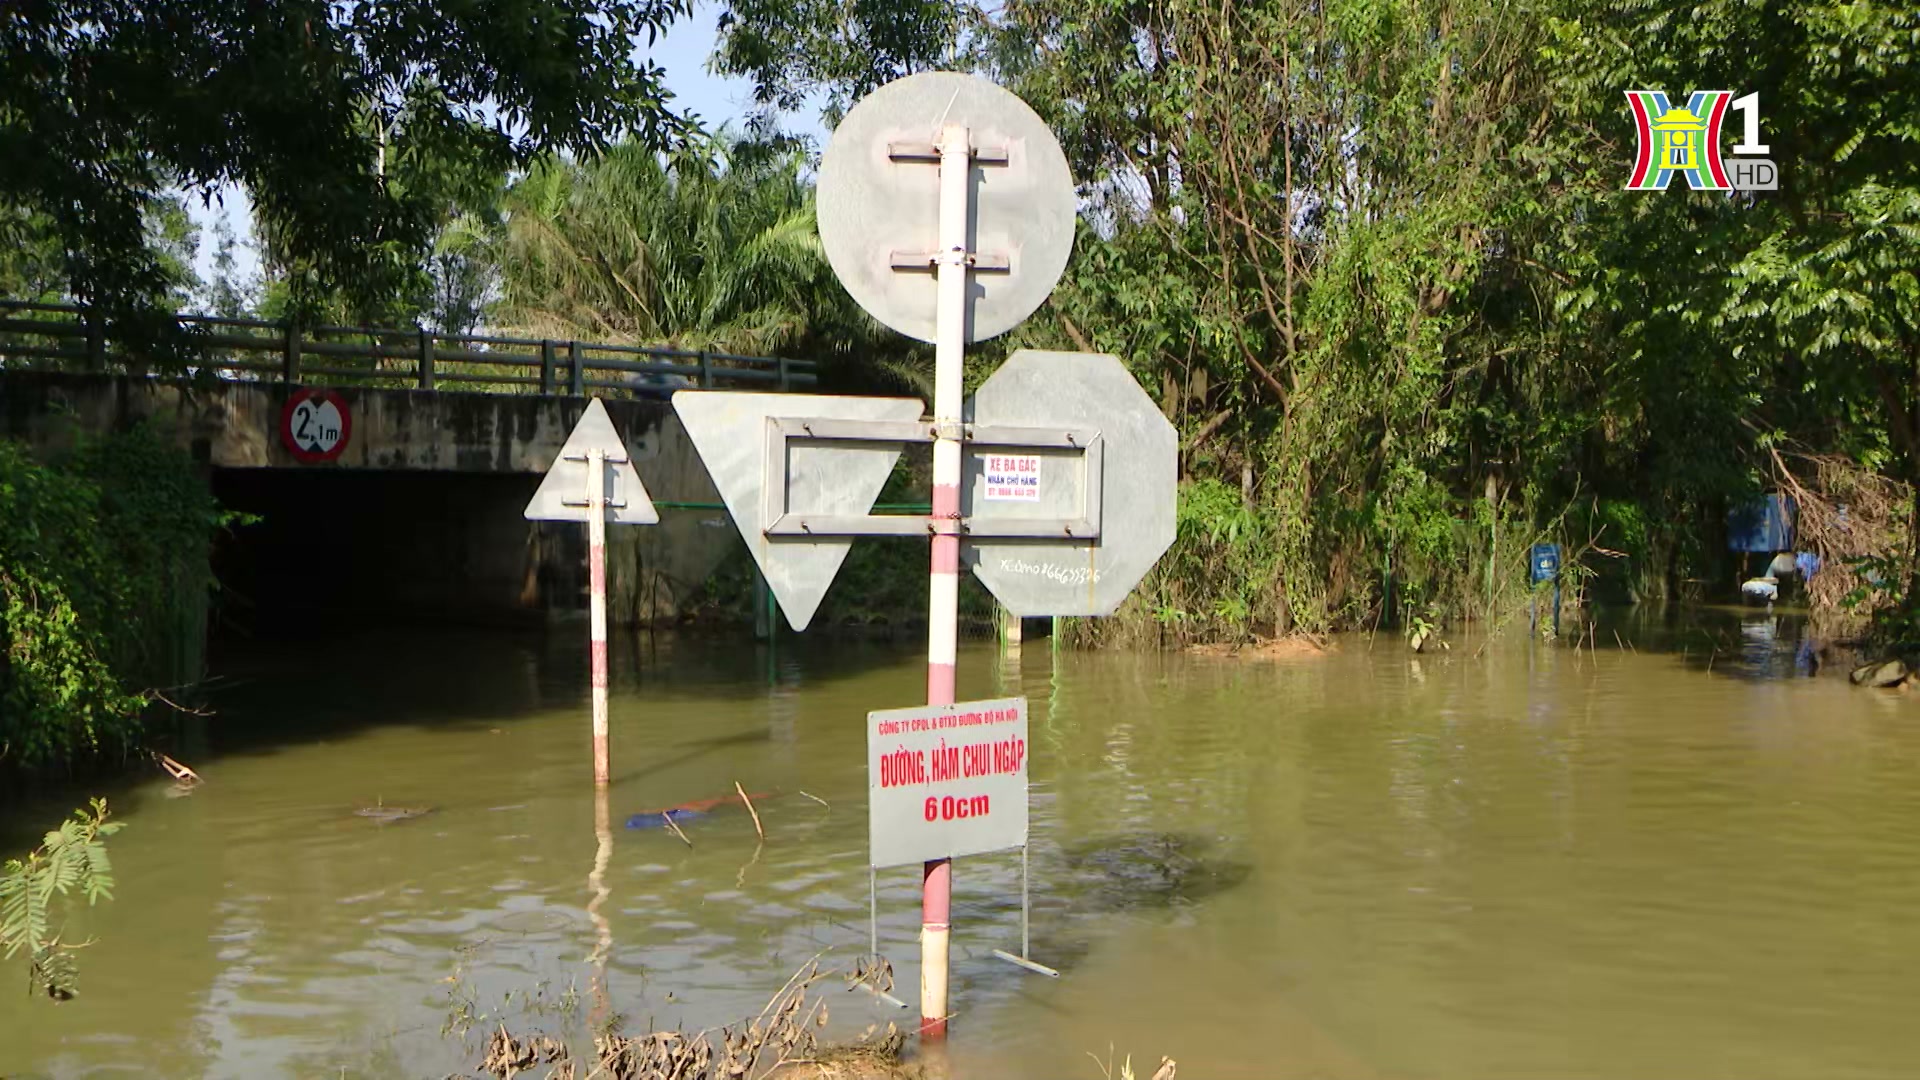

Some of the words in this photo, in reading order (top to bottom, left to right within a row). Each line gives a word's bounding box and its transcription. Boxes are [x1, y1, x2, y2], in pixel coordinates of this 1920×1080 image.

[990, 457, 1001, 472] XE
[1004, 458, 1016, 472] BA
[878, 719, 900, 736] CÔNG
[901, 721, 910, 733] TY
[911, 719, 931, 732] CPQL
[931, 717, 938, 729] &
[995, 708, 1004, 723] HÀ
[931, 737, 959, 782] HẦM
[963, 743, 990, 778] CHUI
[994, 734, 1025, 777] NGẬP
[924, 795, 990, 822] 60cm
